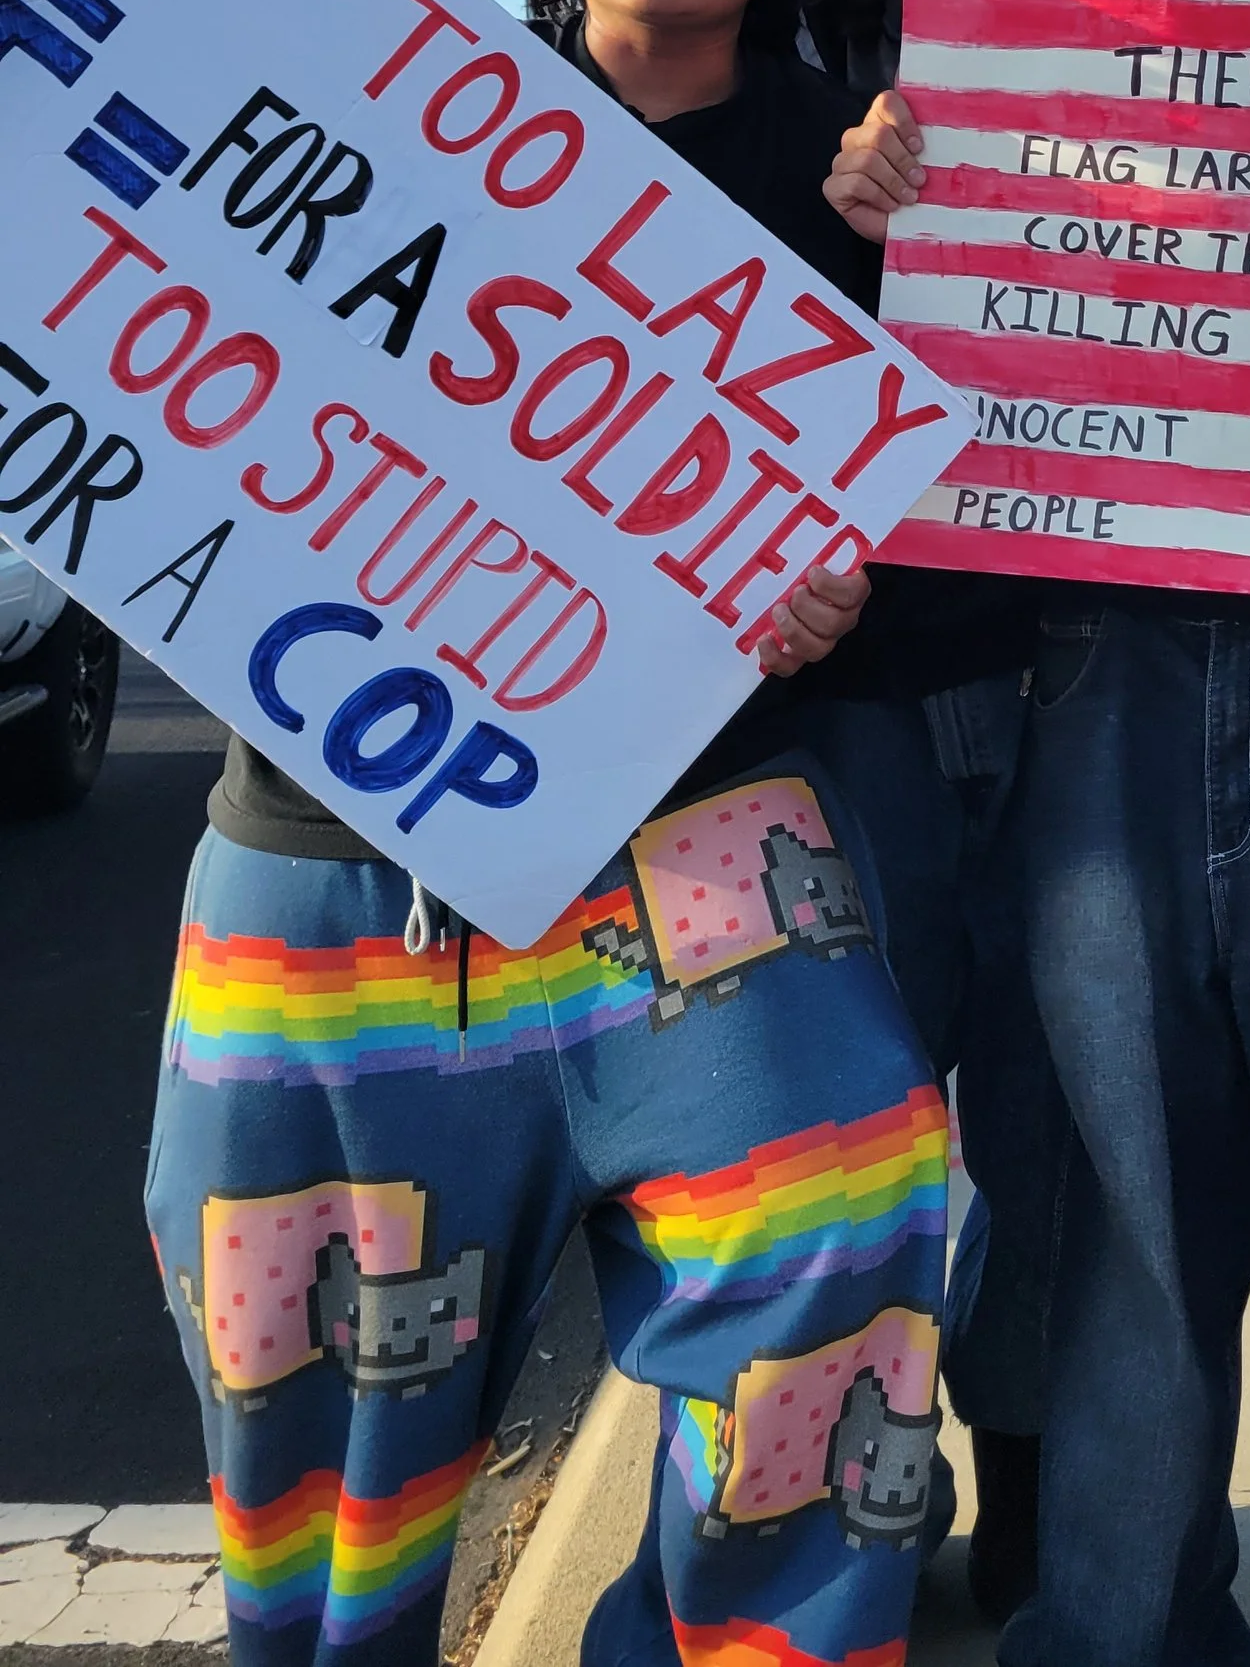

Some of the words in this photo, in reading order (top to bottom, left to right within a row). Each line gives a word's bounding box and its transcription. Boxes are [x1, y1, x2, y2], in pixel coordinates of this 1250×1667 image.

[1020, 134, 1140, 184] FLAG
[179, 85, 374, 285] FOR
[328, 222, 448, 359] A
[1023, 215, 1183, 265] COVER
[576, 180, 949, 492] LAZY
[981, 281, 1232, 356] KILLING
[41, 206, 281, 450] TOO
[240, 402, 608, 713] STUPID
[961, 394, 1190, 457] NOCENT
[953, 489, 1118, 540] PEOPLE
[121, 519, 236, 643] A
[248, 602, 540, 835] COP
